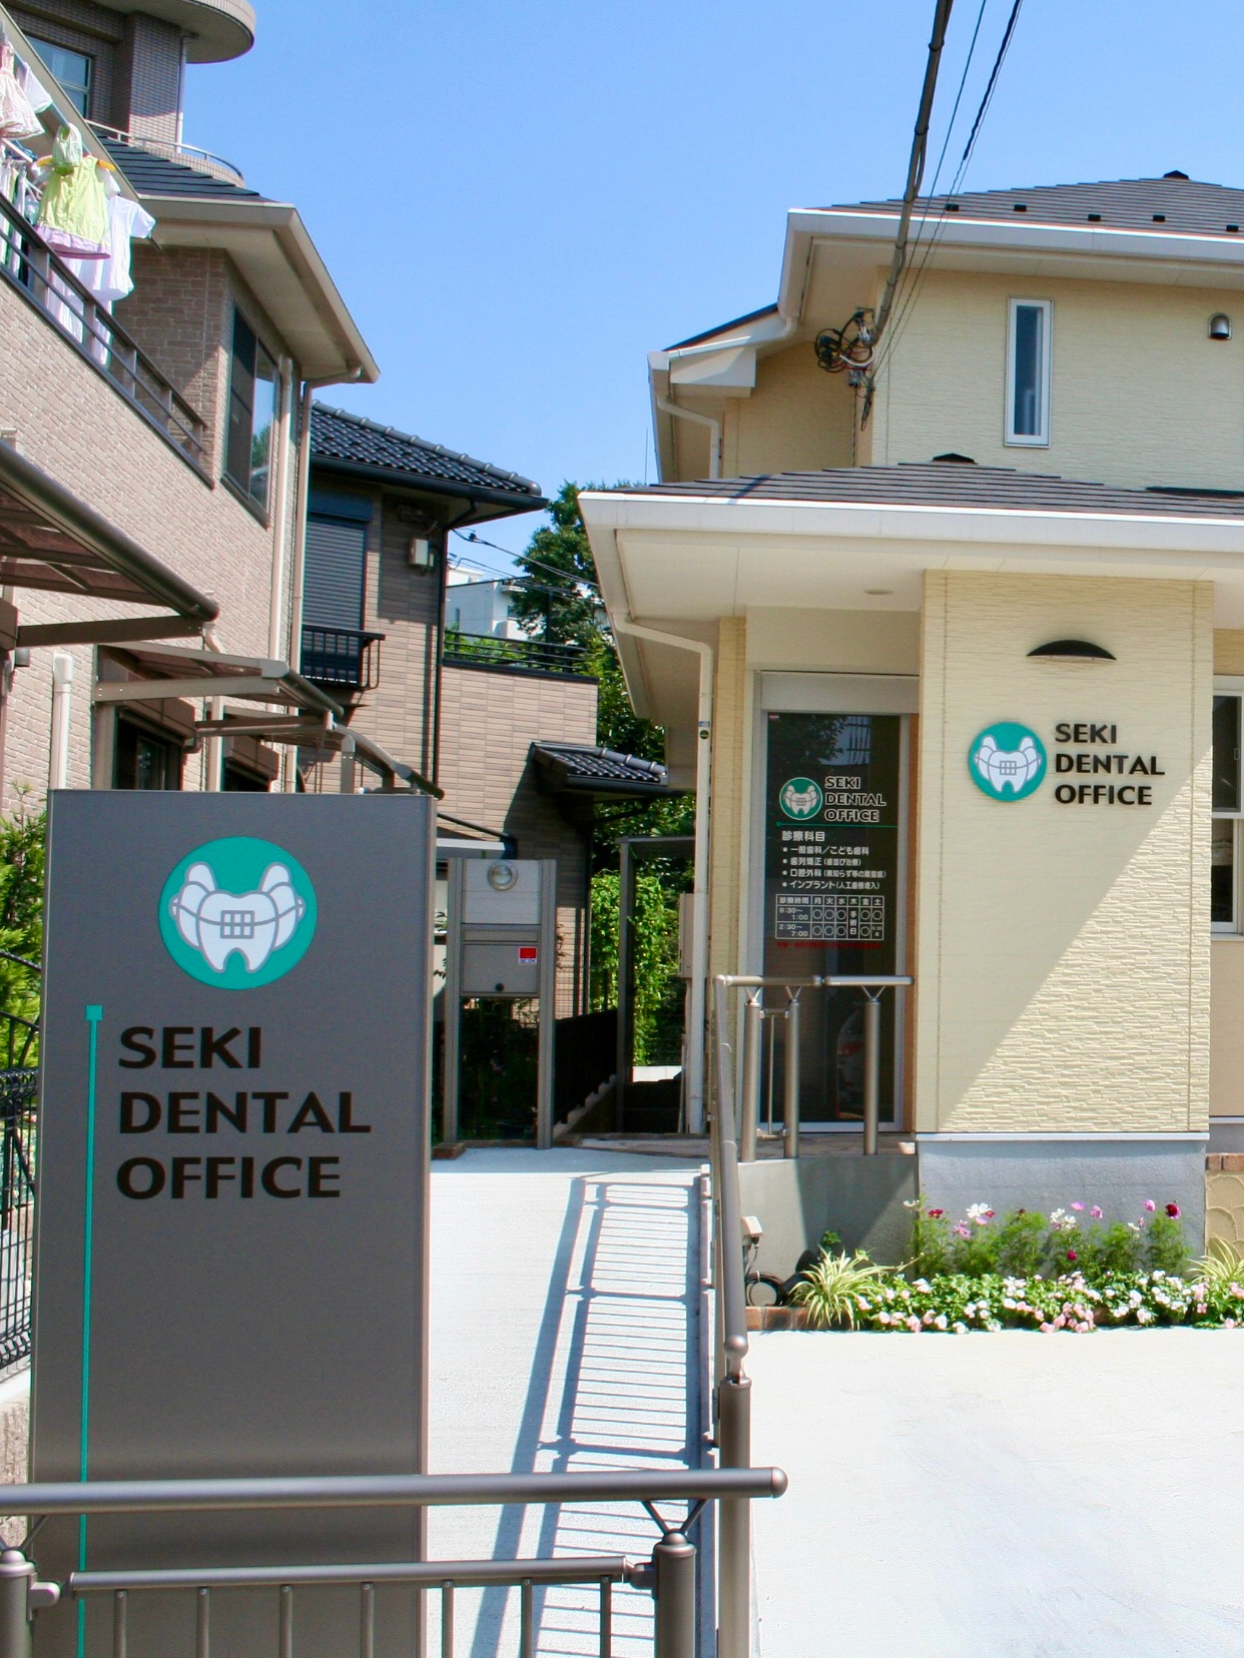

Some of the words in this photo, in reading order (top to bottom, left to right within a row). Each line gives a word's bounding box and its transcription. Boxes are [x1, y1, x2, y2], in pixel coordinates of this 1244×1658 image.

[1055, 723, 1117, 744] SEKI
[1055, 753, 1165, 775] DENTAL
[824, 776, 861, 789] SEKI
[824, 793, 887, 806] DENTAL
[1055, 784, 1152, 805] OFFICE
[824, 809, 880, 822] OFFICE
[781, 831, 825, 841] 診療科目
[118, 1026, 262, 1069] SEKI
[119, 1091, 372, 1134] DENTAL
[116, 1156, 341, 1200] OFFICE
